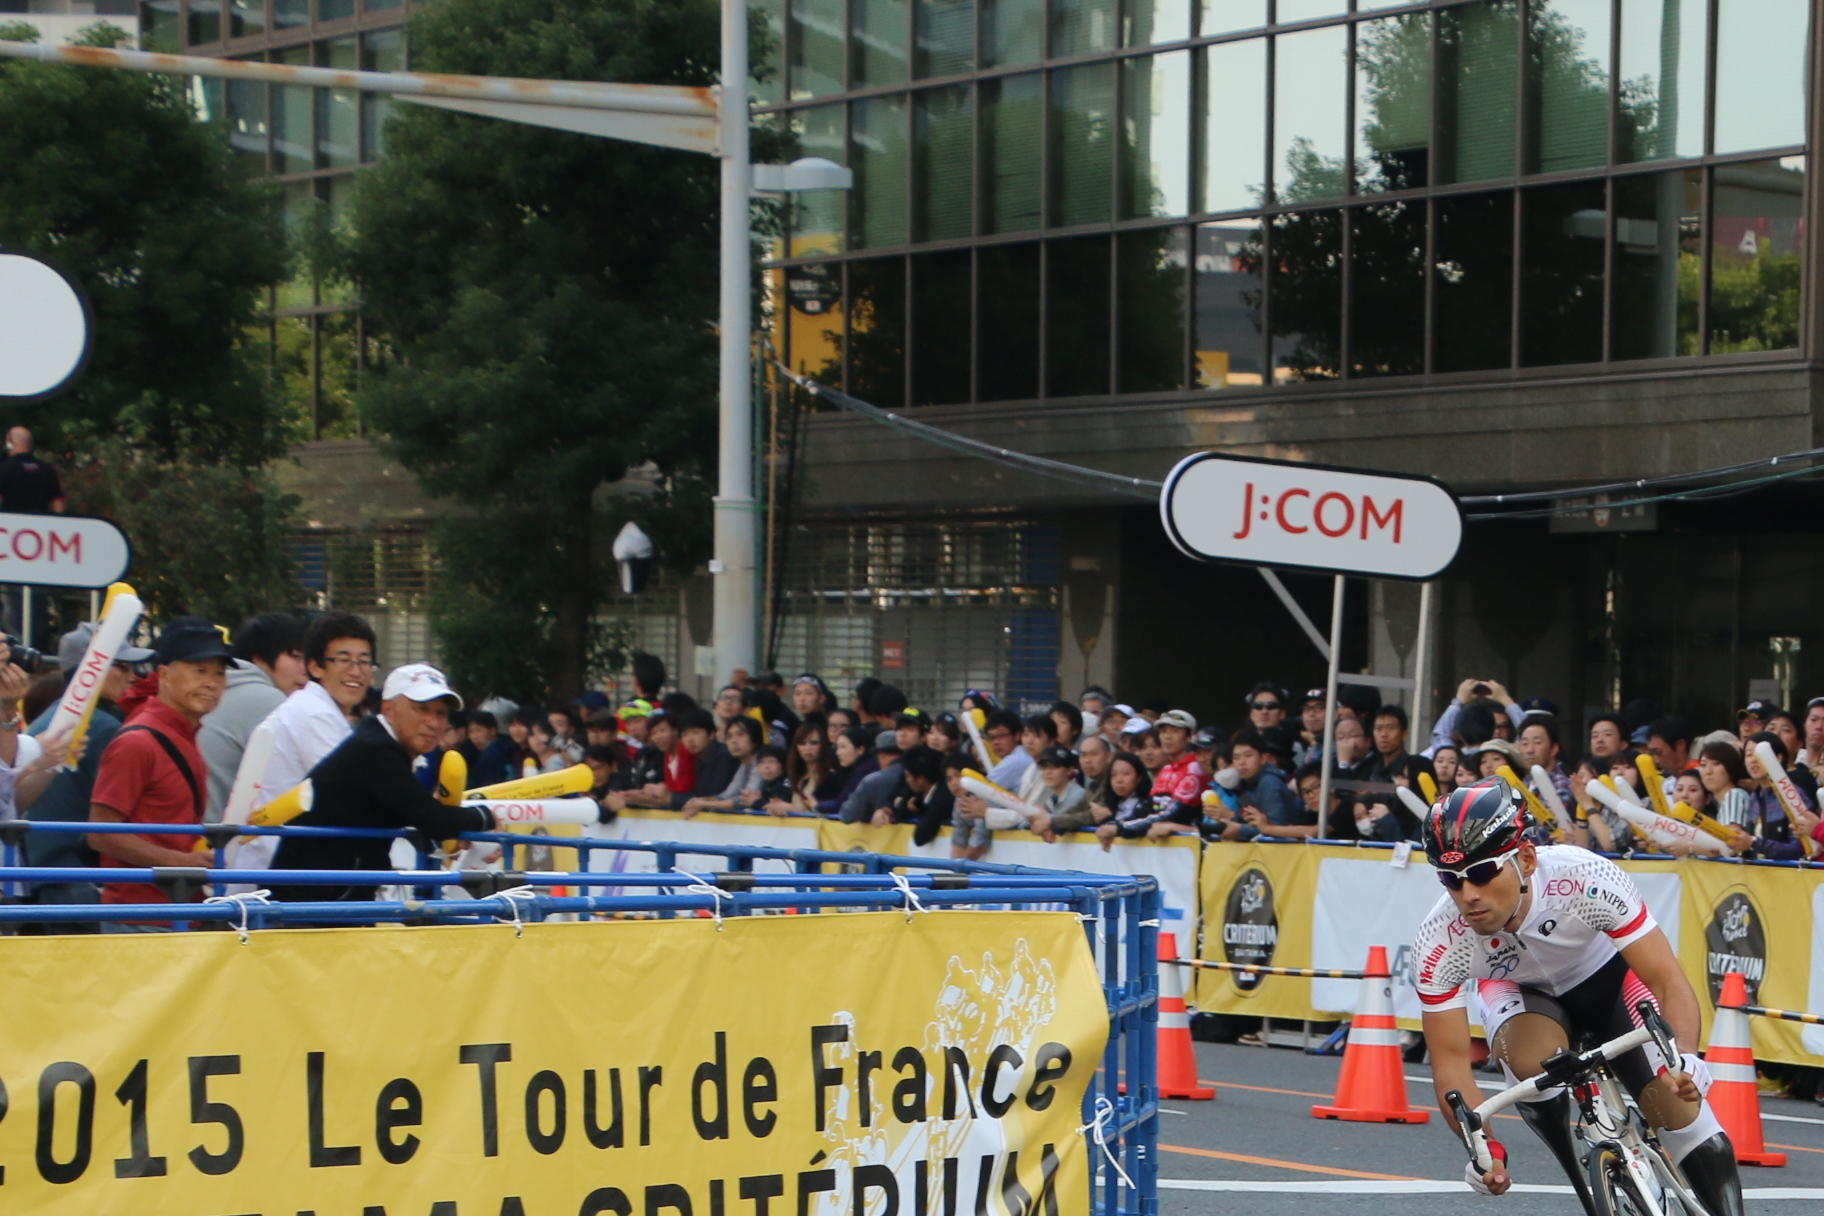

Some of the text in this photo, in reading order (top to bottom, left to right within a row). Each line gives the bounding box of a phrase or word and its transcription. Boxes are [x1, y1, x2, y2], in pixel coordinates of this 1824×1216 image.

[1233, 483, 1403, 544] J:COM
[64, 648, 110, 717] J:COM
[1600, 889, 1629, 917] NIPPO
[1486, 945, 1516, 963] JAPAN
[306, 1052, 423, 1168] Le
[459, 1043, 663, 1158] Tour
[691, 1032, 778, 1141] de
[811, 1025, 1073, 1132] France
